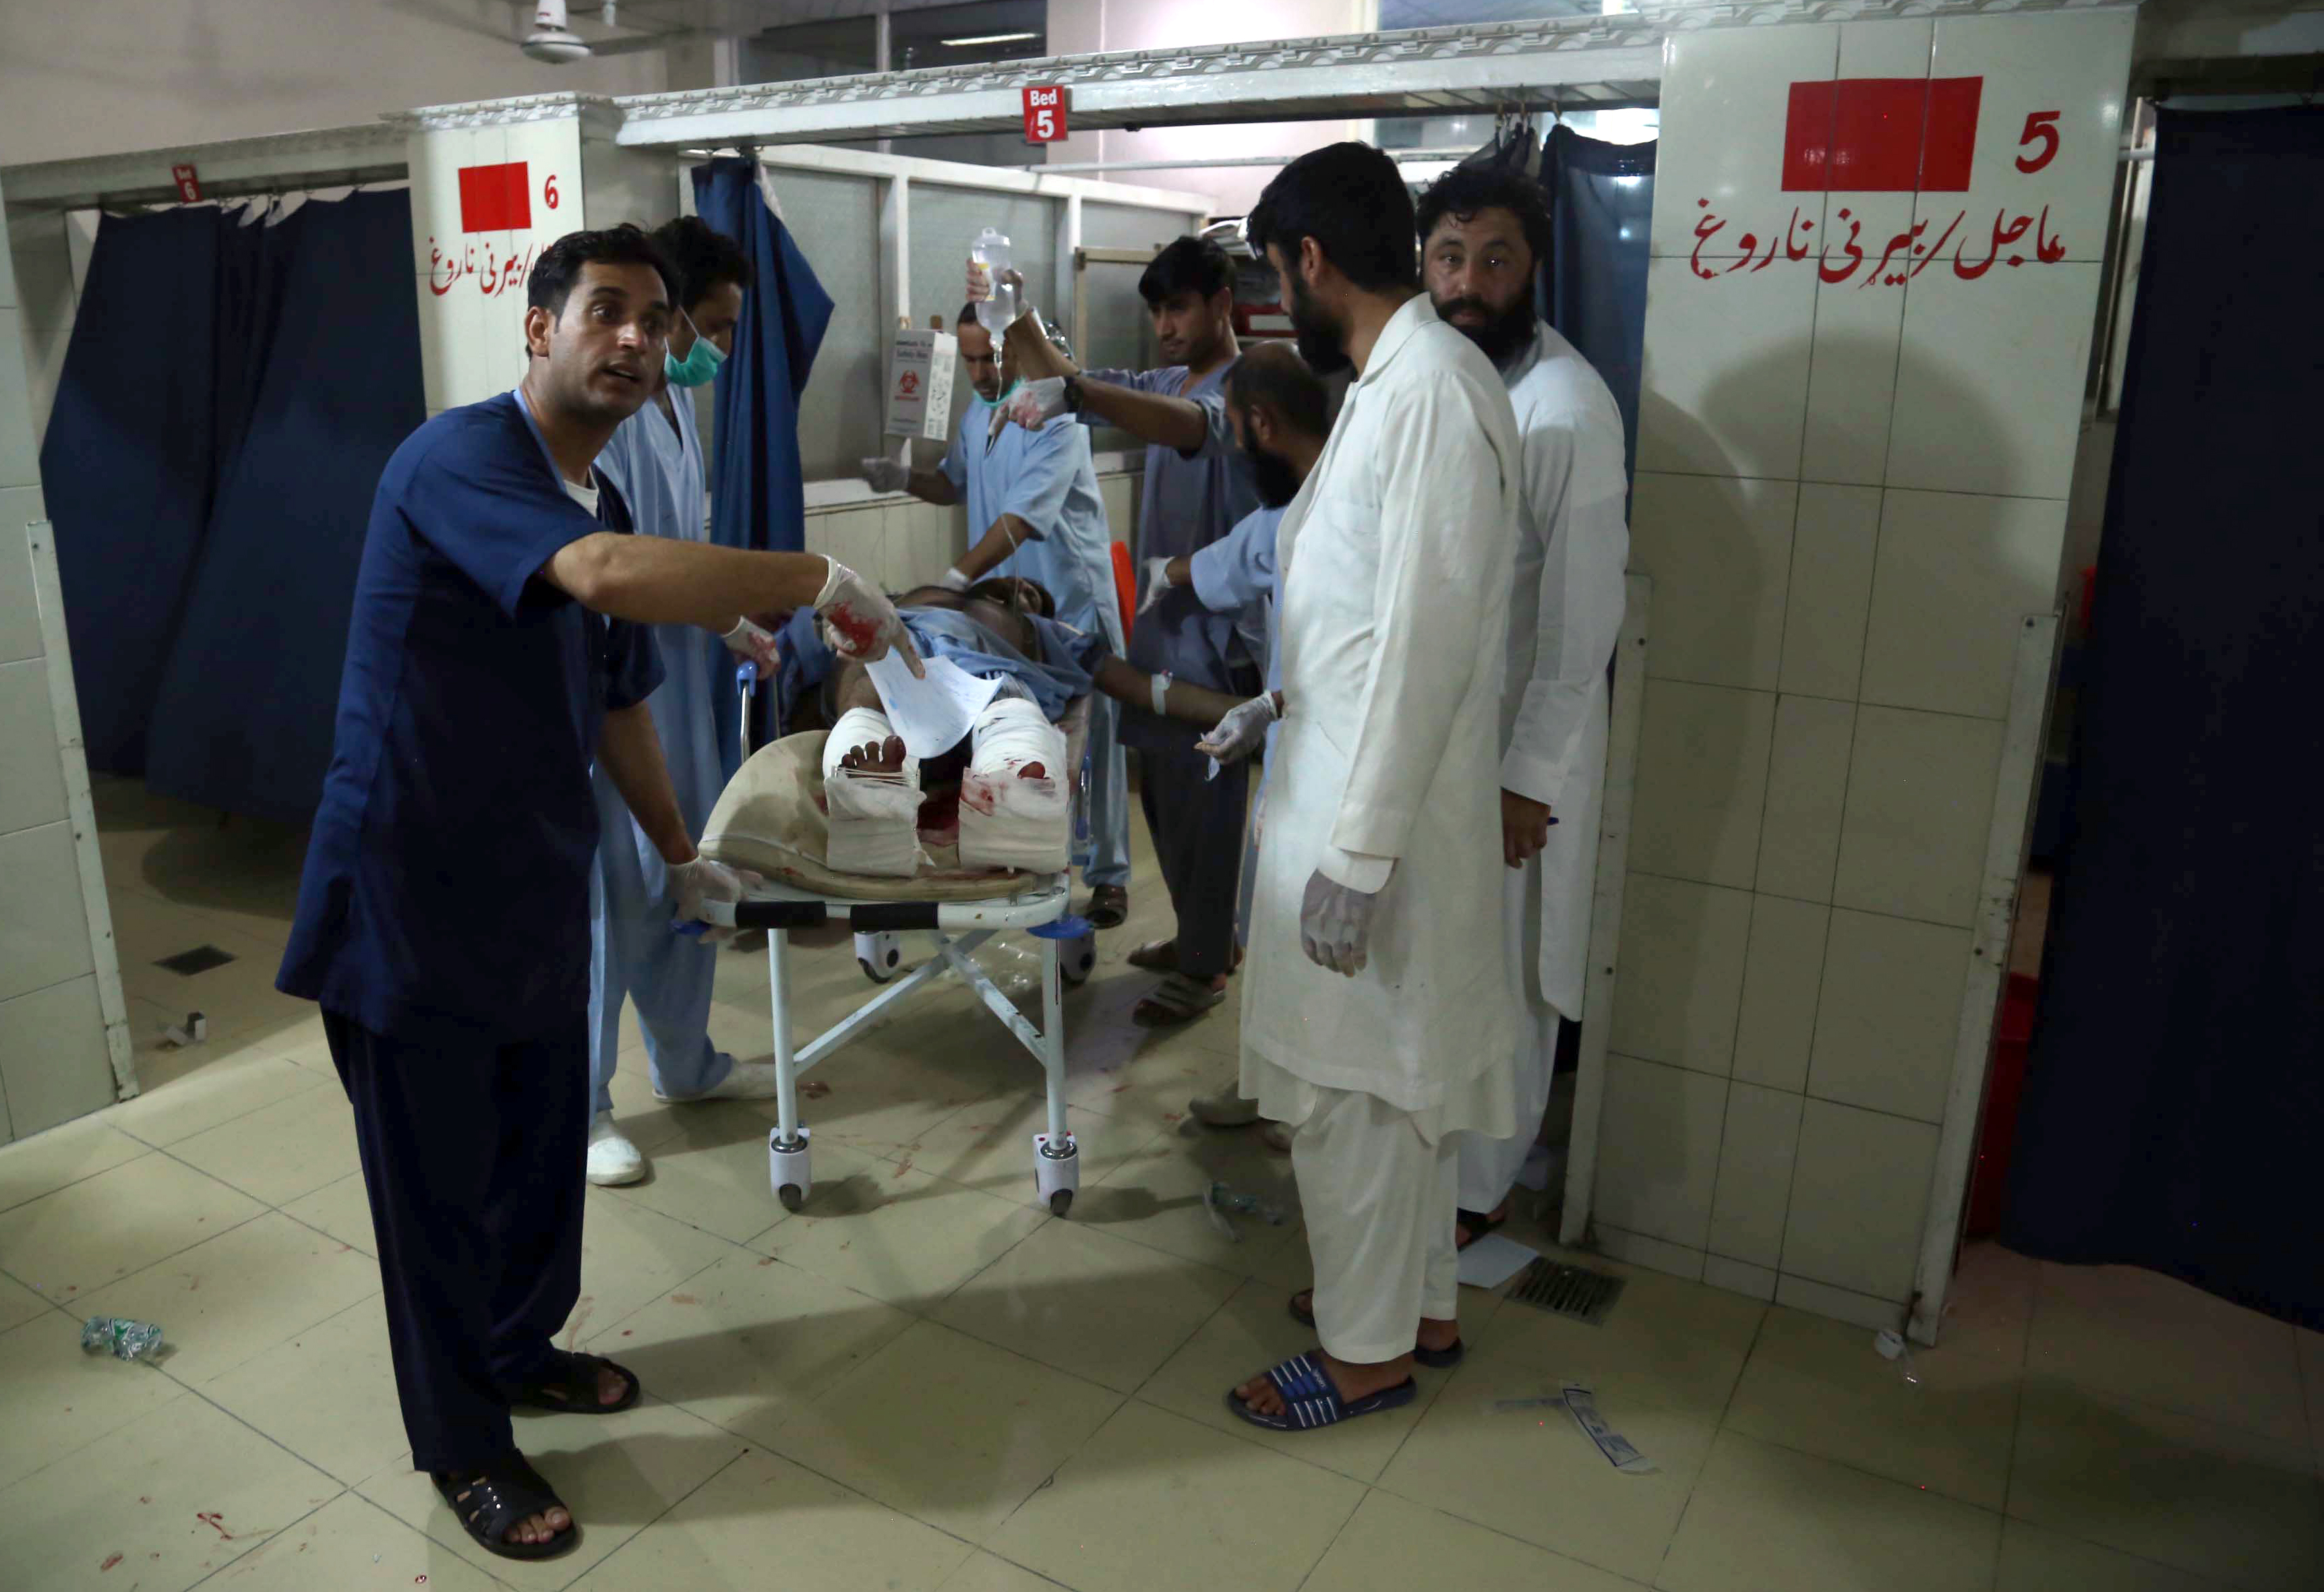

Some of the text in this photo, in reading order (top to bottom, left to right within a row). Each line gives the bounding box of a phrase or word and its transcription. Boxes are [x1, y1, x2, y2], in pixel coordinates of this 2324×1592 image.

[1030, 88, 1057, 106] Bed
[1038, 110, 1054, 138] 5
[2015, 110, 2060, 173] 5
[183, 181, 197, 200] 6
[544, 175, 559, 210] 6
[1691, 199, 1814, 280] ناروغ
[429, 237, 476, 297] ناروغ
